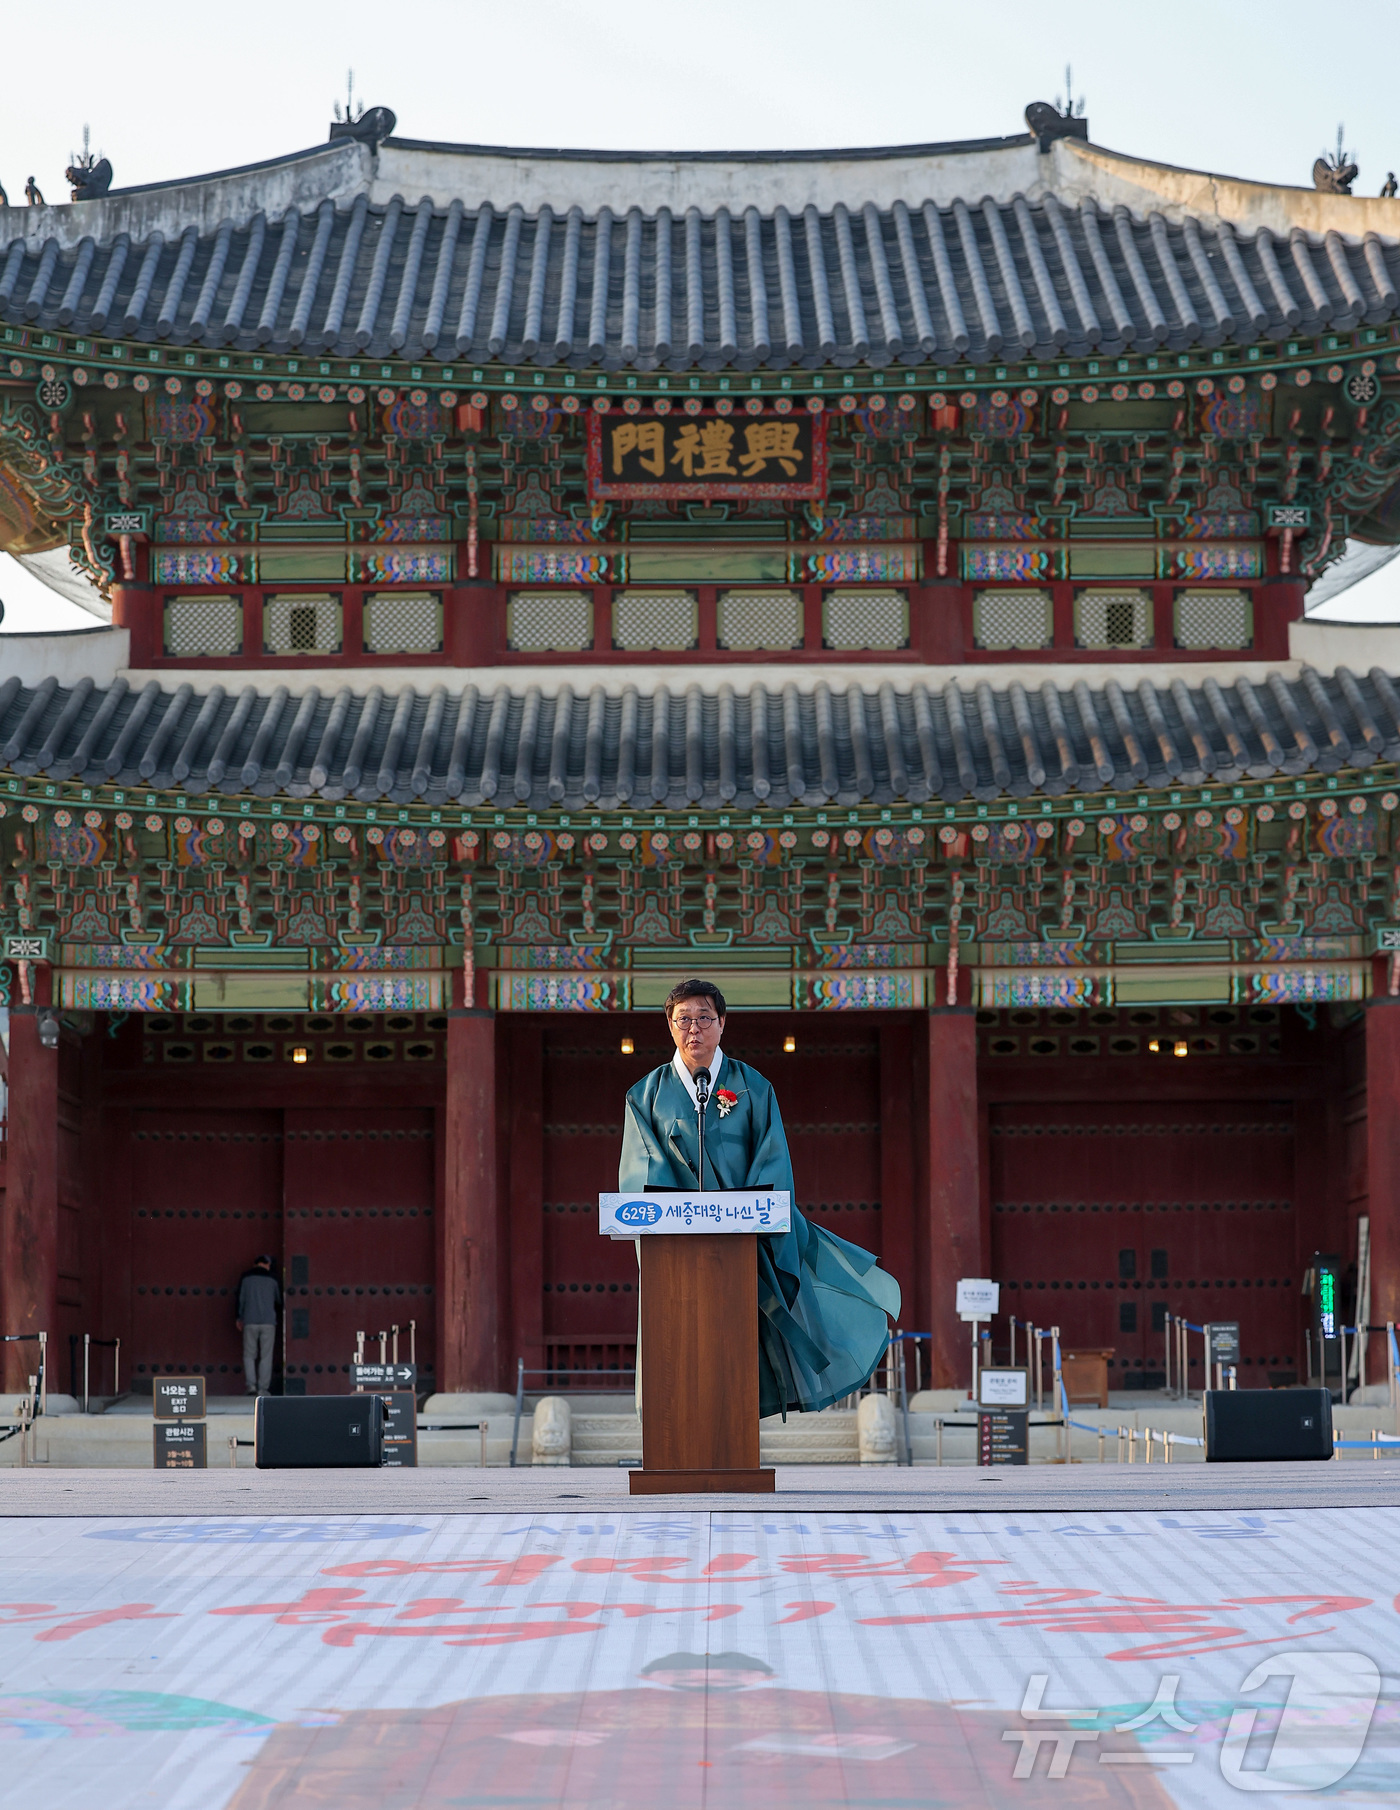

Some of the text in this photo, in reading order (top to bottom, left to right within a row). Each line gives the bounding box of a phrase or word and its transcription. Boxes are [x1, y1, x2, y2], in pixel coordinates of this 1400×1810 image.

[621, 1198, 776, 1225] 629돌 세종대왕 나신 날
[386, 1366, 394, 1376] 문
[161, 1385, 198, 1396] 나오는 문
[501, 1521, 916, 1541] 세종대왕
[945, 1525, 1155, 1537] 나신
[1157, 1516, 1295, 1539] 날
